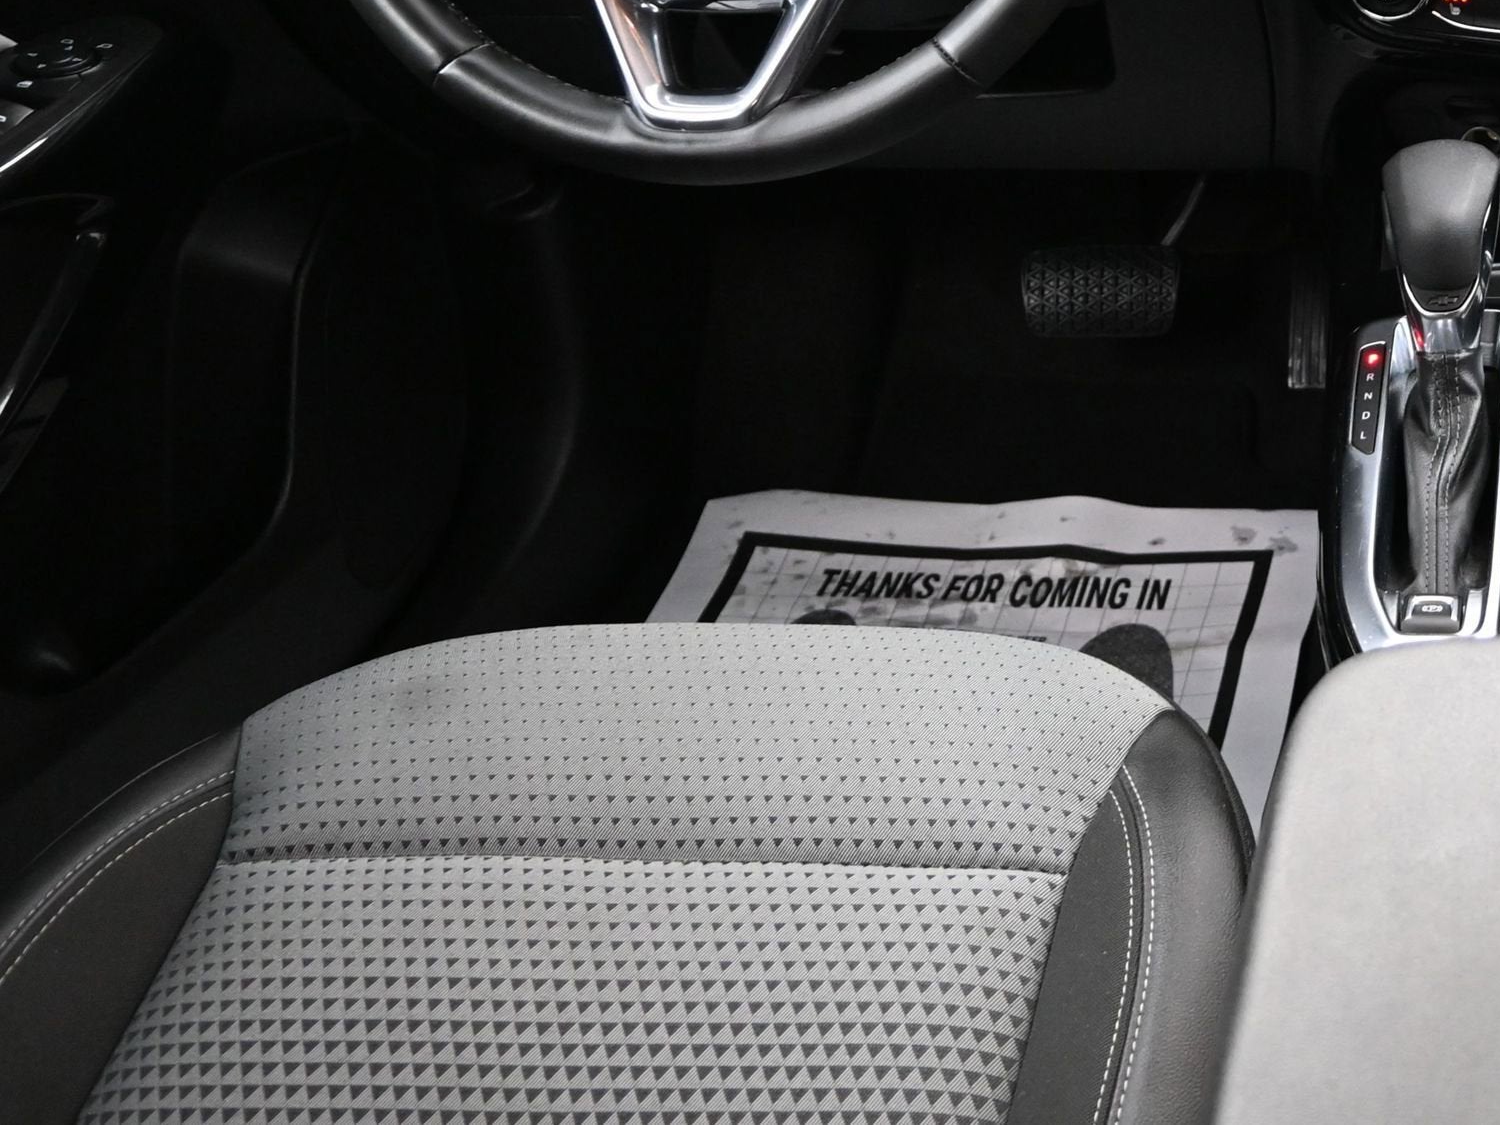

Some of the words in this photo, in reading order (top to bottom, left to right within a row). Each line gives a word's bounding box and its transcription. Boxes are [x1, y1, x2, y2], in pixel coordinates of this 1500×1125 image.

[1367, 353, 1379, 365] P
[1366, 372, 1374, 382] R
[1364, 392, 1373, 400] N
[1361, 411, 1371, 420] D
[1360, 431, 1367, 440] L
[816, 568, 941, 600] THANKS
[942, 573, 1005, 603] FOR
[1009, 576, 1132, 609] COMING
[1136, 578, 1172, 610] IN
